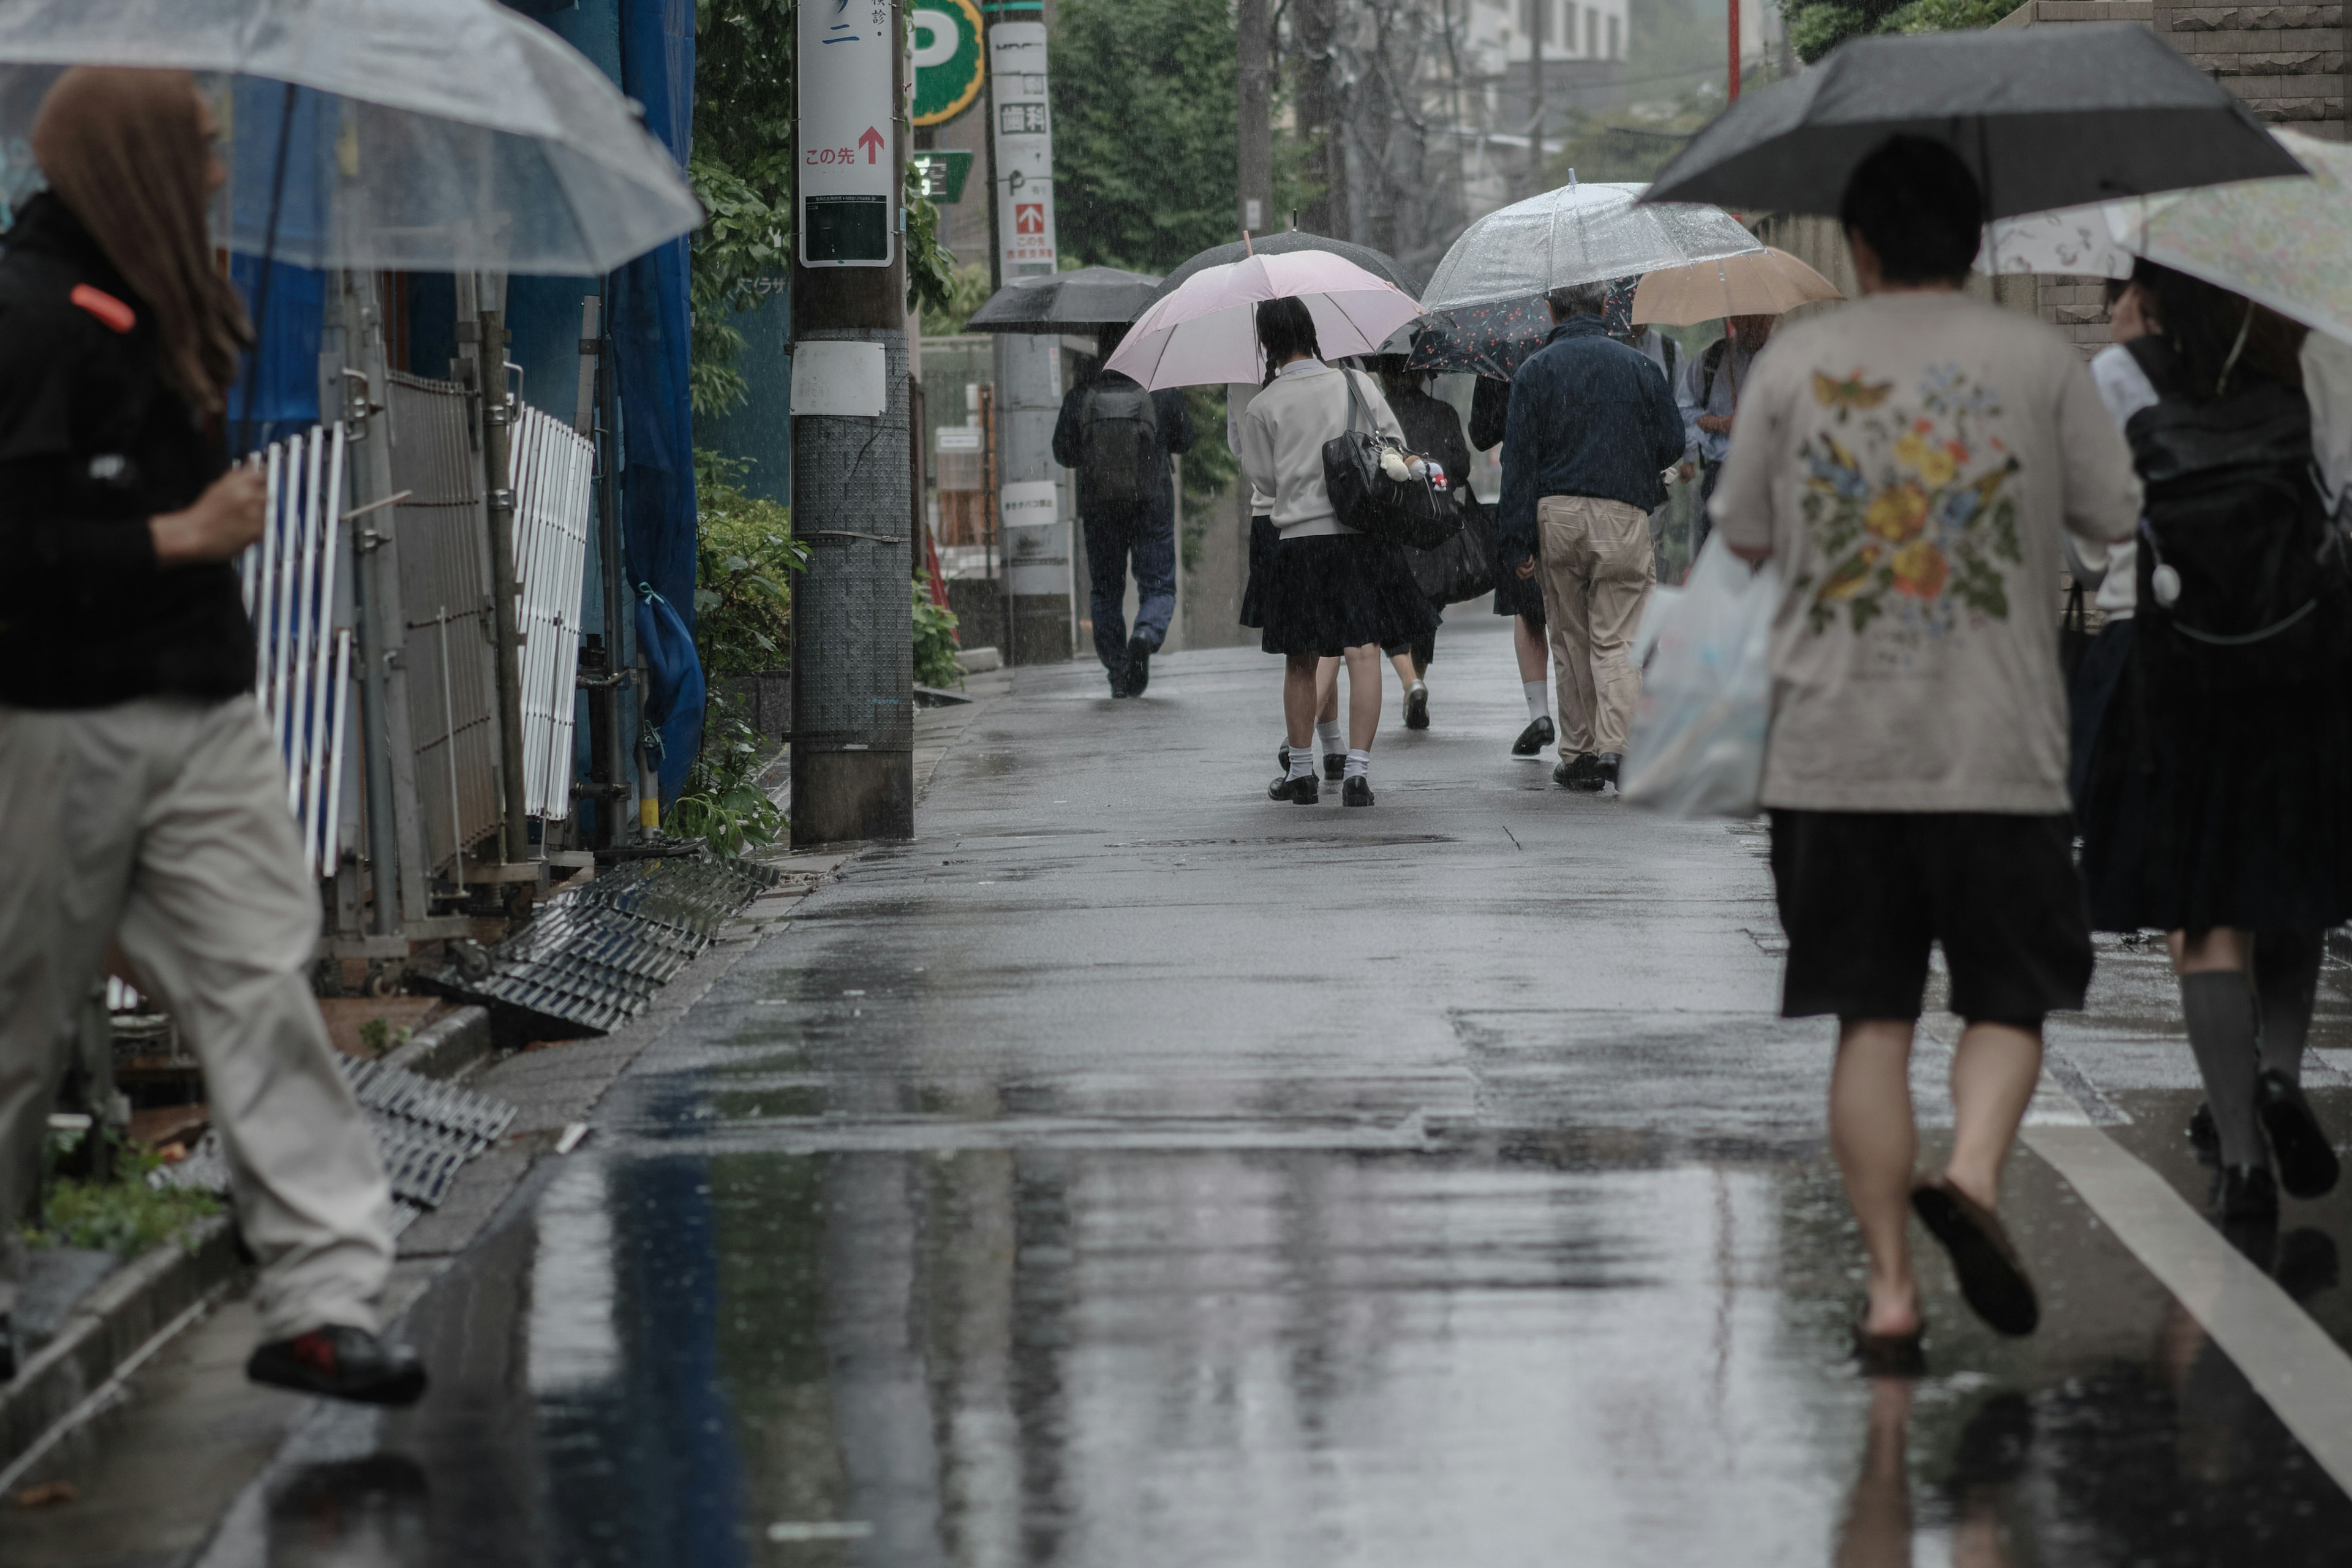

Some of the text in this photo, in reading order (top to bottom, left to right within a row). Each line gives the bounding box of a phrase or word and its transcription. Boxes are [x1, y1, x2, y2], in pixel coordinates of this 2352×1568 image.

[910, 9, 960, 100] P
[1001, 106, 1045, 132] 歯科
[806, 148, 855, 165] この先
